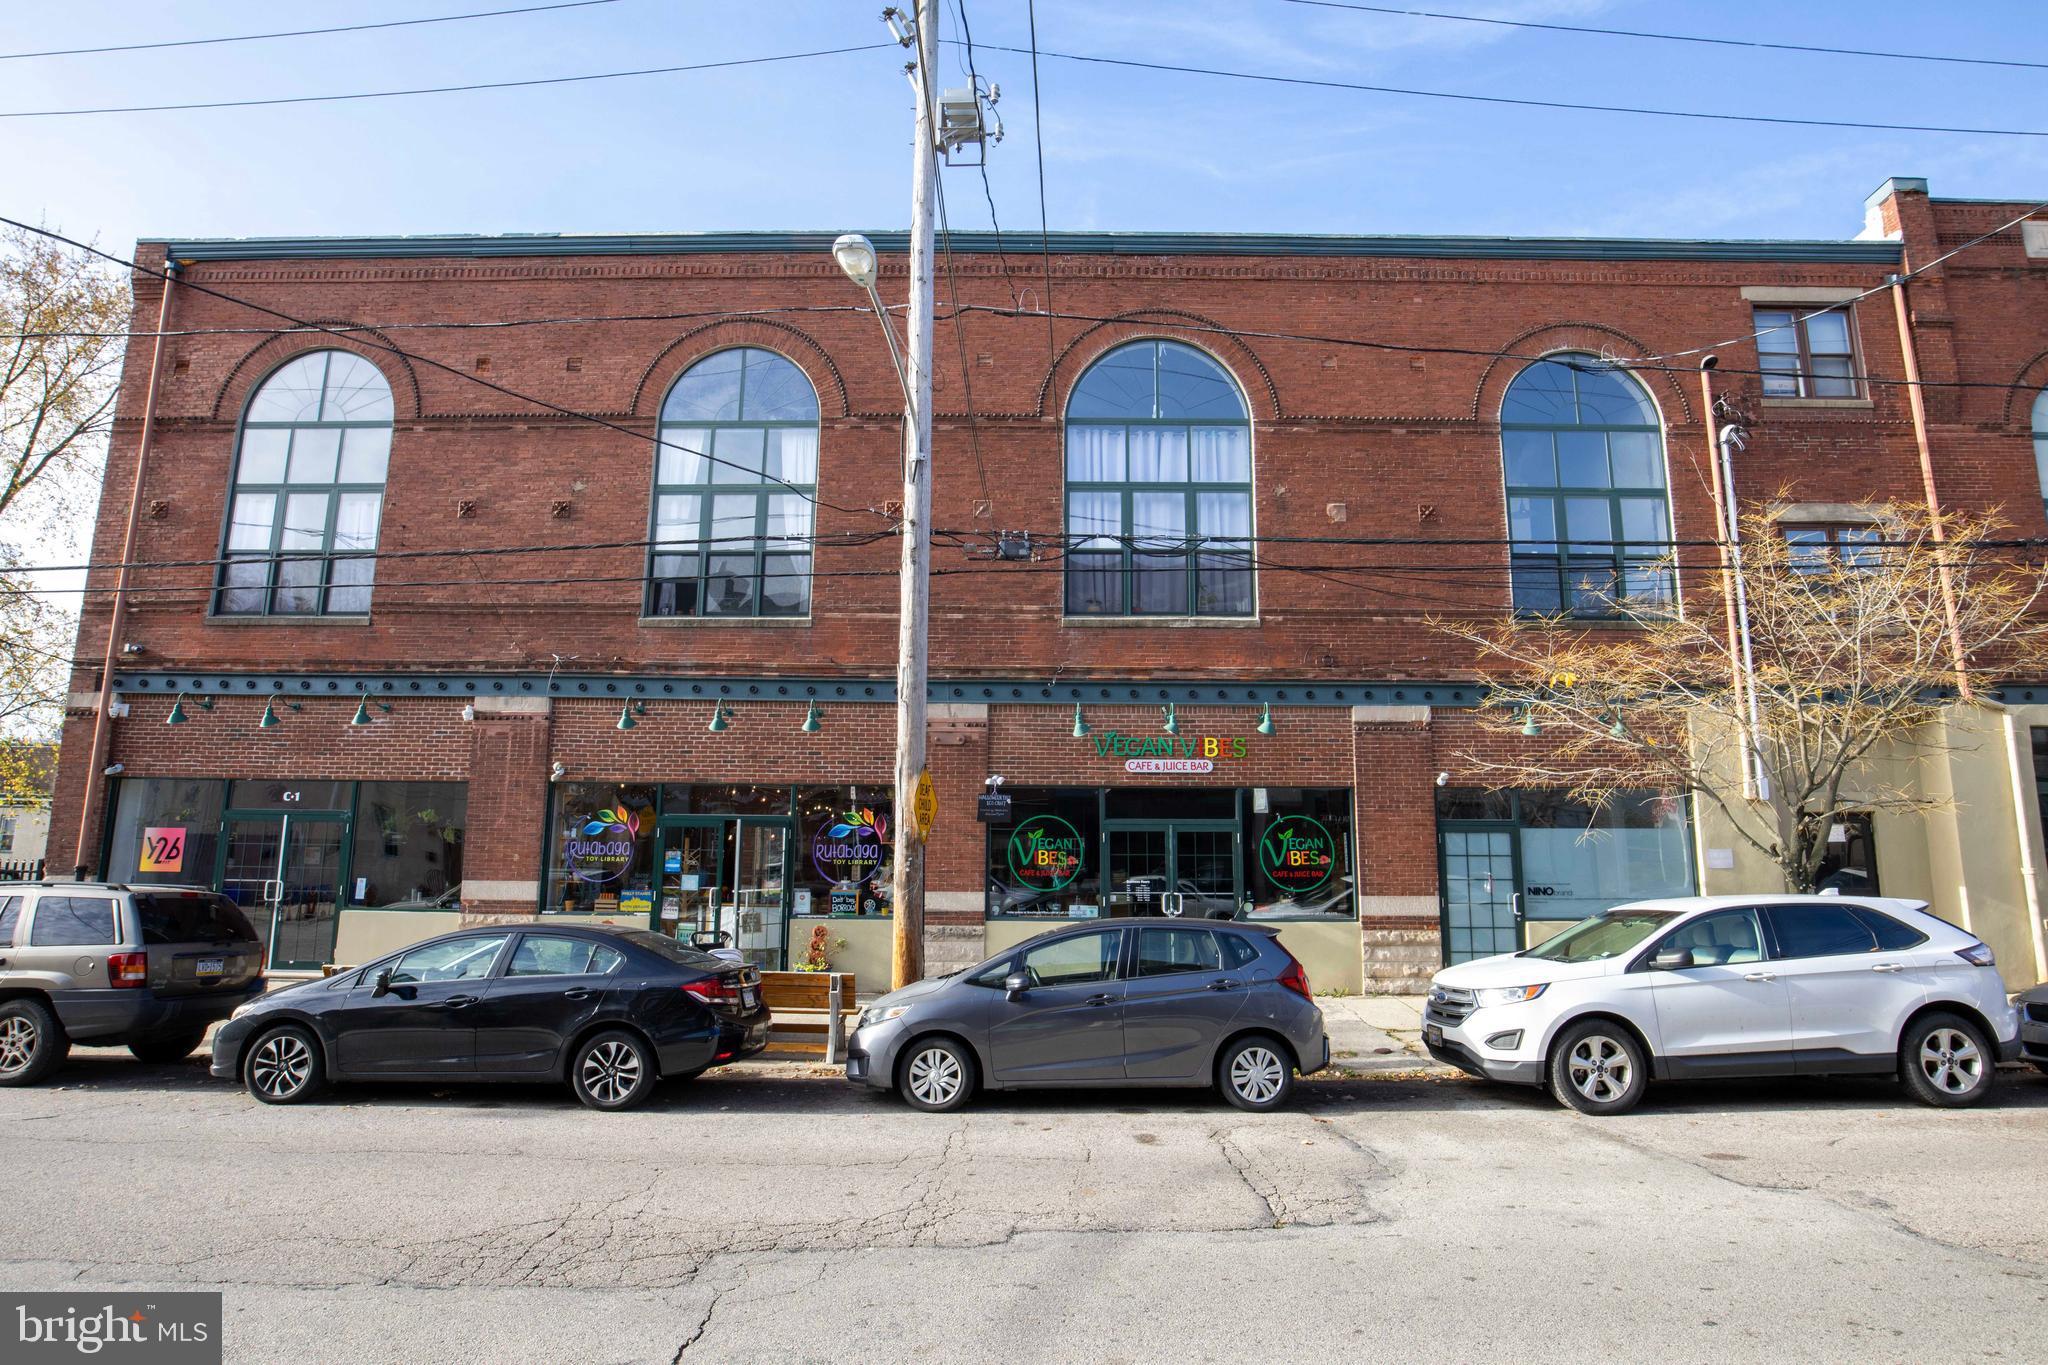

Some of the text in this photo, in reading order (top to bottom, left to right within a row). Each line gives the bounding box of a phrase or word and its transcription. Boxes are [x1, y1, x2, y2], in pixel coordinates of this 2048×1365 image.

[1093, 733, 1248, 758] VEGAN VIBES
[1128, 761, 1152, 771] CAFE
[1162, 761, 1188, 771] JUICE
[1190, 761, 1209, 771] BAR
[919, 783, 931, 796] DEAF
[919, 798, 932, 811] CHILD
[919, 813, 931, 826] AREA
[569, 841, 631, 859] Rutabaga
[816, 844, 878, 862] Rutabaga
[1019, 869, 1035, 877] CAFE
[1272, 870, 1288, 878] CAFE
